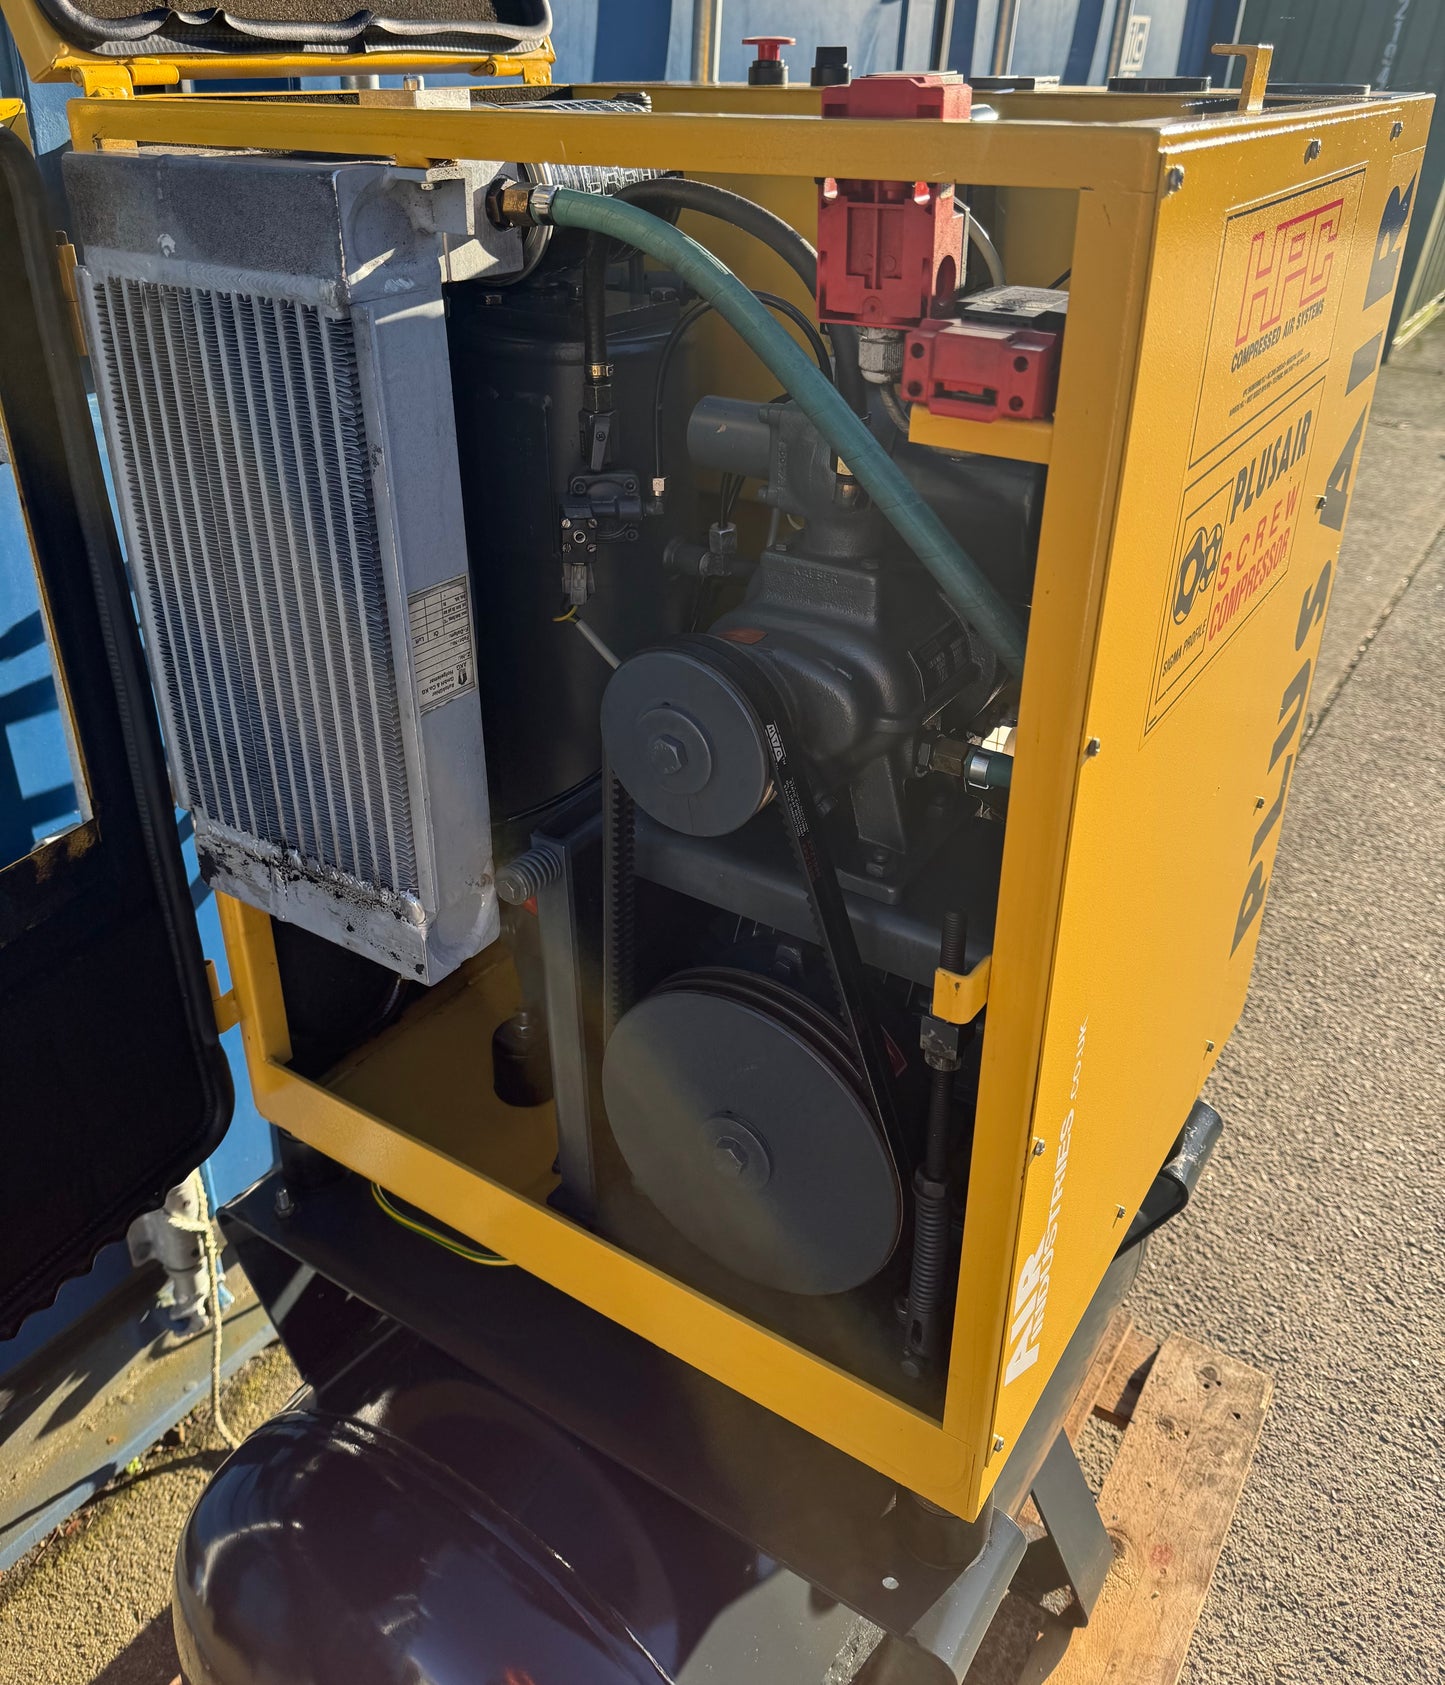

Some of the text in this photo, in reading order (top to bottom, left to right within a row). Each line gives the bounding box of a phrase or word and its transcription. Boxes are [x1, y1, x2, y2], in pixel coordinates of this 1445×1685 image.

[1231, 298, 1325, 373] COMPRESSED AIR SYSTEMS
[1229, 410, 1312, 525] PLUSAIR
[1209, 527, 1290, 641] COMPRESSOR
[1218, 482, 1300, 591] SCREW
[1162, 618, 1208, 677] SIGMA PROFILE
[1031, 1108, 1075, 1344] INDUSTRIES
[1004, 1232, 1048, 1387] AIR
